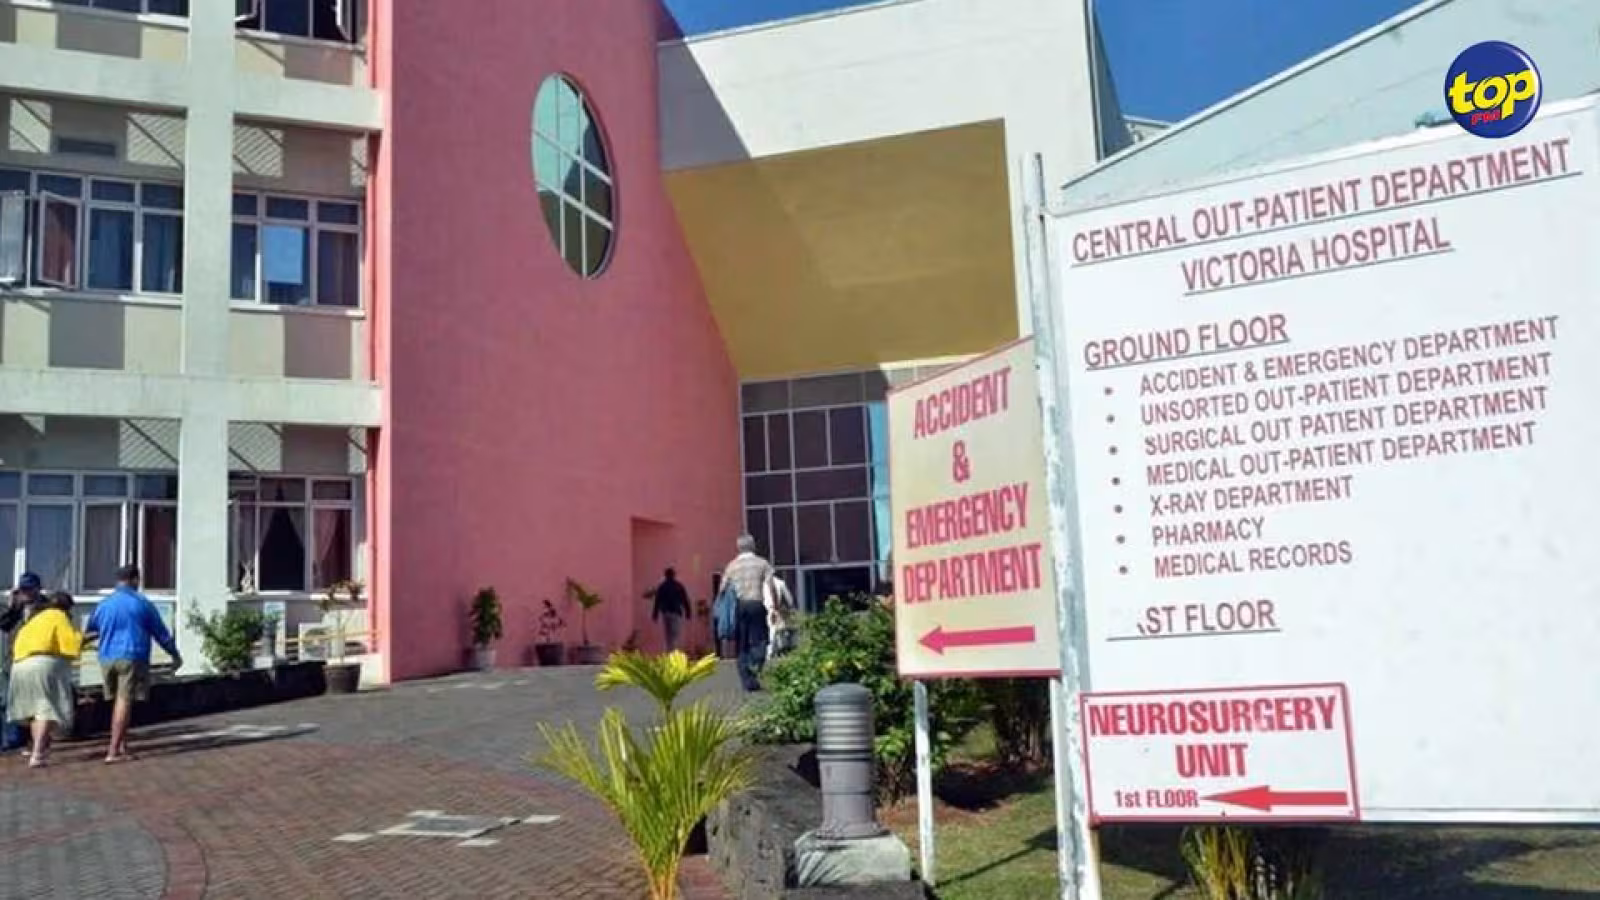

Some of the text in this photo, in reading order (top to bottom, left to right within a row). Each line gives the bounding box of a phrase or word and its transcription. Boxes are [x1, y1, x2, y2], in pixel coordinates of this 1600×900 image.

[1073, 138, 1571, 261] CENTRAL OUT-PATIENT DEPARTMENT
[1181, 216, 1450, 290] VICTORIA HOSPITAL
[1084, 314, 1288, 366] GROUND FLOOR
[1140, 316, 1560, 396] ACCIDENT & EMERGENCY DEPARTMENT
[914, 367, 1011, 439] ACCIDENT
[1141, 352, 1553, 425] UNSORTED OUT-PATIENT DEPARTMENT
[1146, 386, 1548, 455] SURGICAL OUT PATIENT DEPARTMENT
[953, 440, 970, 483] &
[1147, 421, 1537, 486] MEDICAL OUT-PATIENT DEPARTMENT
[907, 482, 1028, 549] EMERGENCY
[1151, 476, 1353, 517] X-RAY DEPARTMENT
[1152, 517, 1265, 547] PHARMACY
[1155, 541, 1352, 578] MEDICAL RECORDS
[903, 543, 1041, 603] DEPARTMENT
[1137, 600, 1276, 634] ST FLOOR
[1089, 695, 1336, 736] NEUROSURGERY
[1175, 743, 1248, 778] UNIT
[1114, 790, 1199, 807] 1st FLOOR
